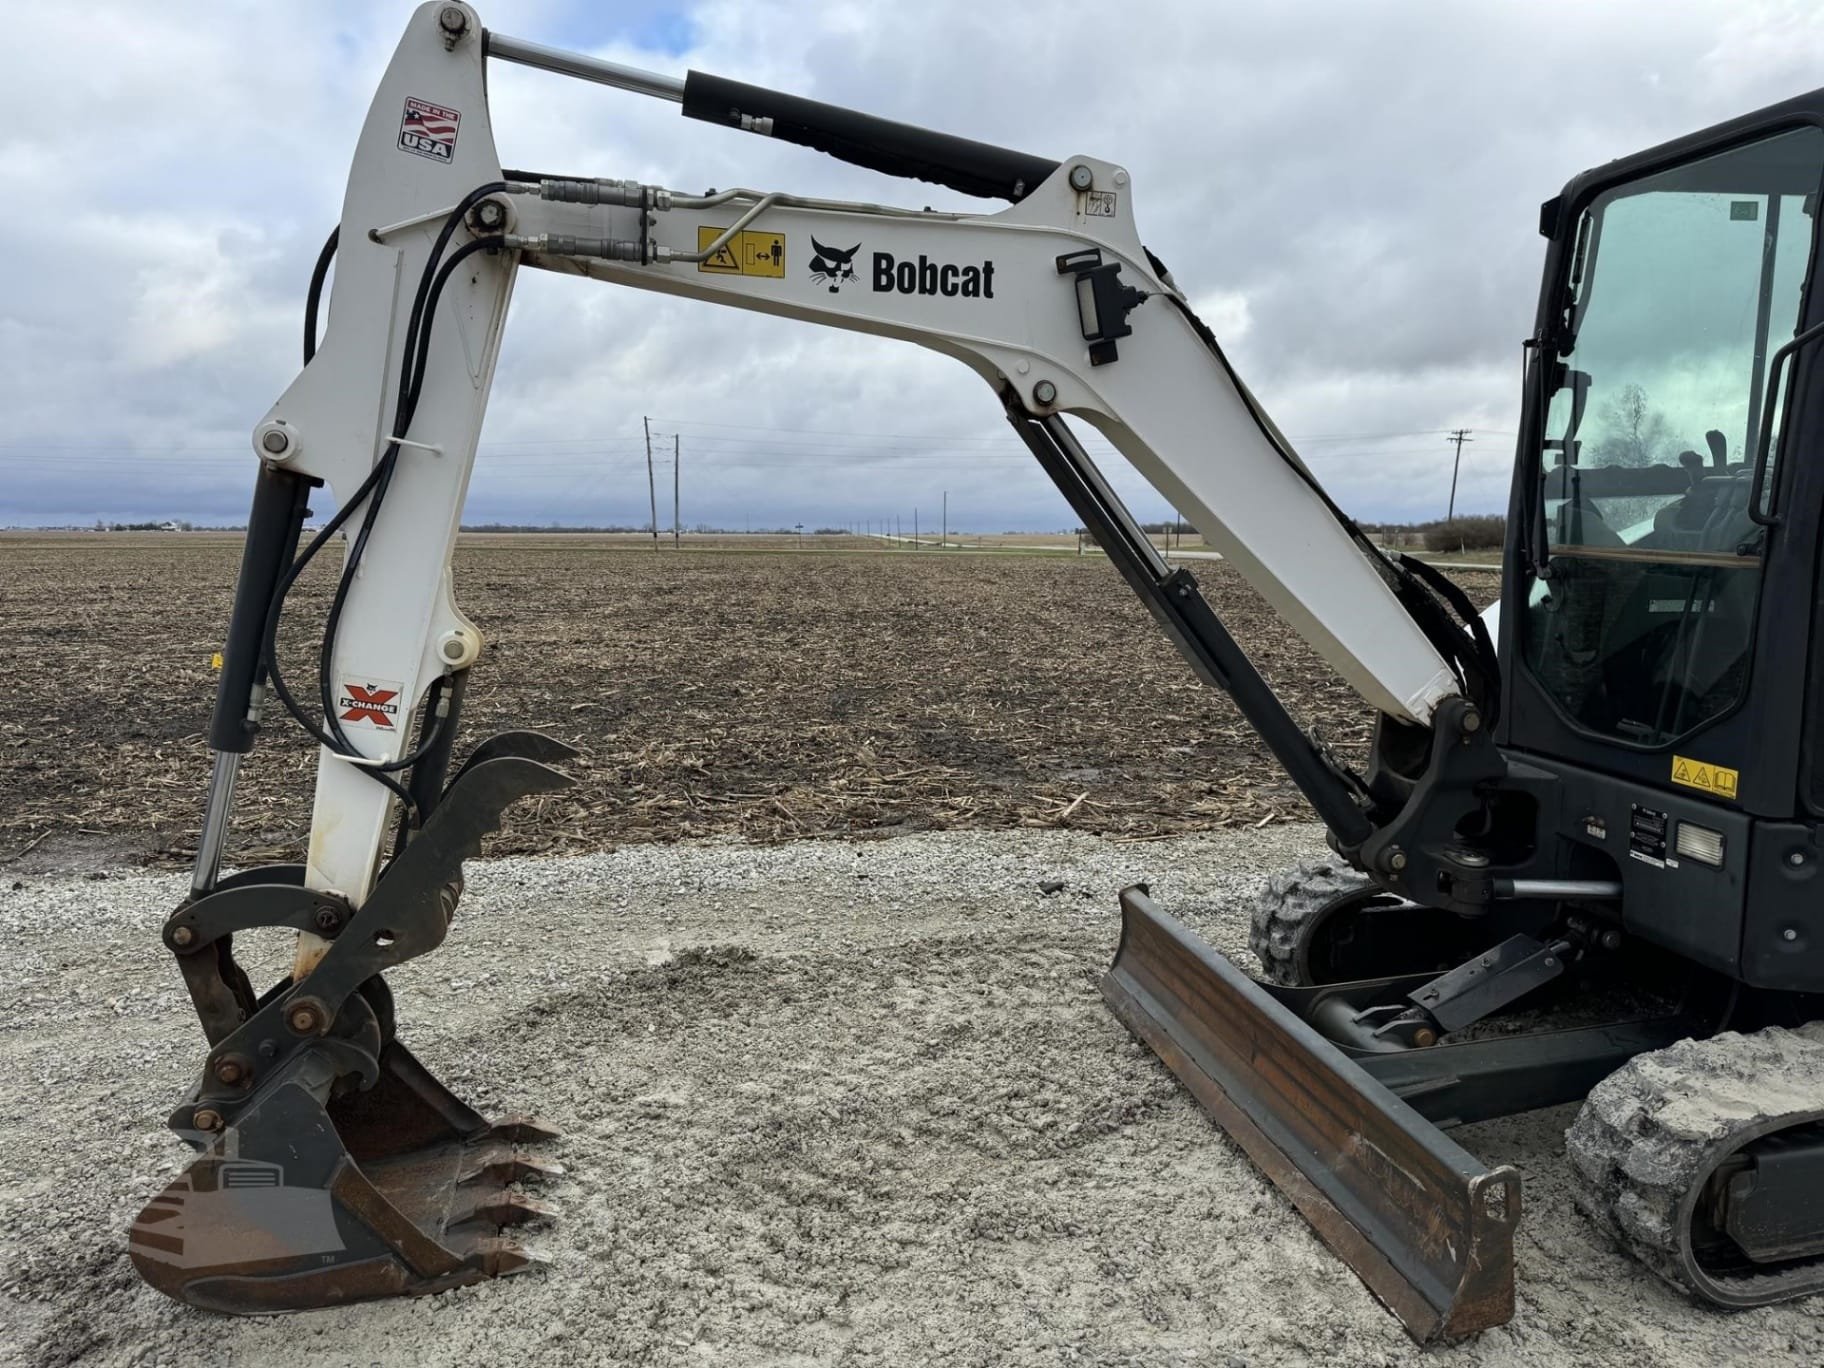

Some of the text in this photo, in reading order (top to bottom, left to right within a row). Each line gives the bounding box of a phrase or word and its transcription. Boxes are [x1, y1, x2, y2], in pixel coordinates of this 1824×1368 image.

[410, 102, 455, 120] MADE IN THE
[403, 133, 448, 157] USA
[873, 252, 995, 299] Bobcat
[342, 699, 395, 713] X-CHANGE
